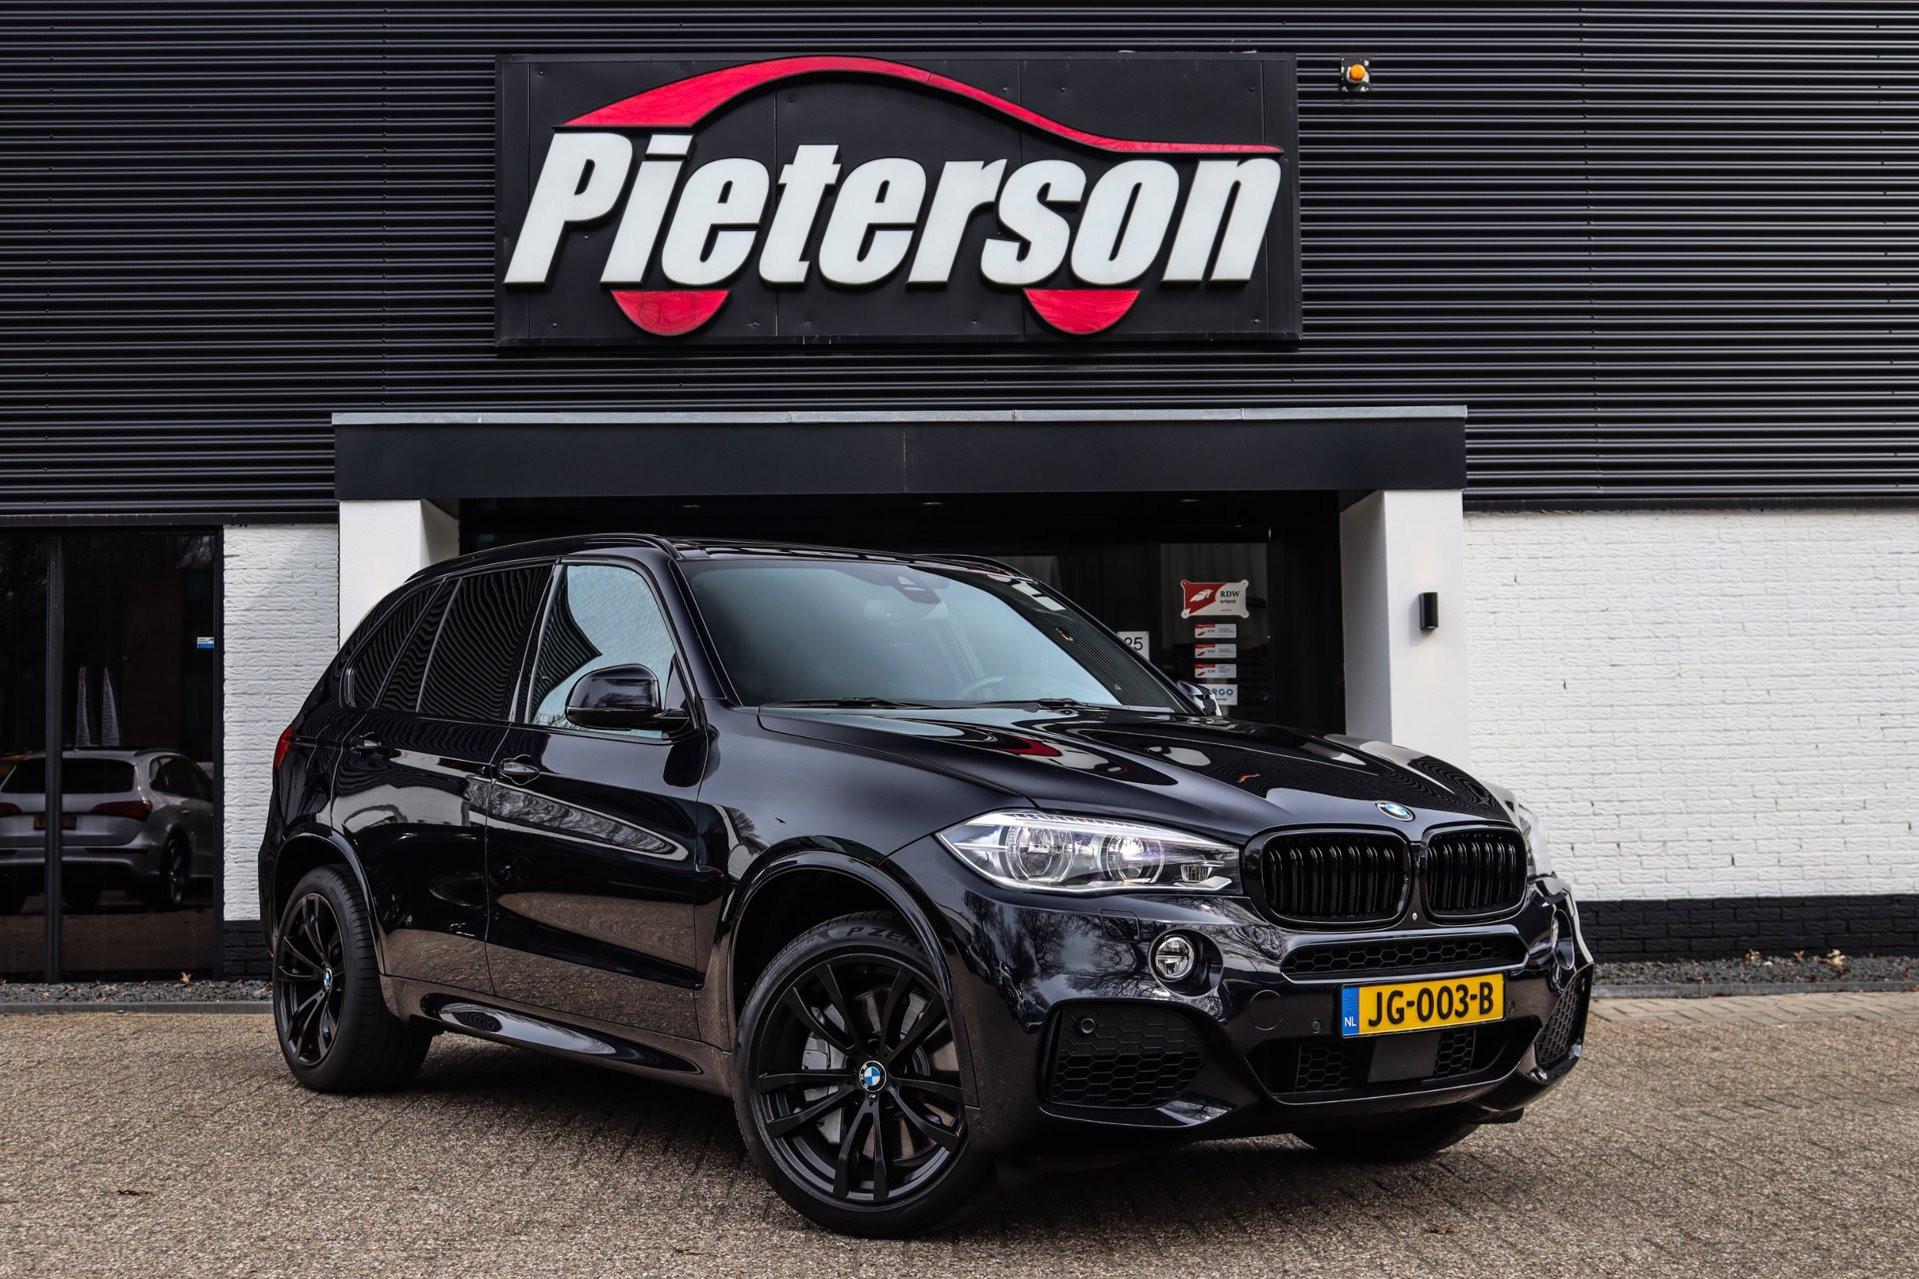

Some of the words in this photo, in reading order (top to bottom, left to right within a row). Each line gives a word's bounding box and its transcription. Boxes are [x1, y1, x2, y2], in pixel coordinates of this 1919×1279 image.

[503, 132, 1282, 286] Pieterson
[1220, 590, 1240, 598] RDW
[1368, 981, 1494, 1027] JG-003-B
[1344, 1016, 1357, 1028] NL
